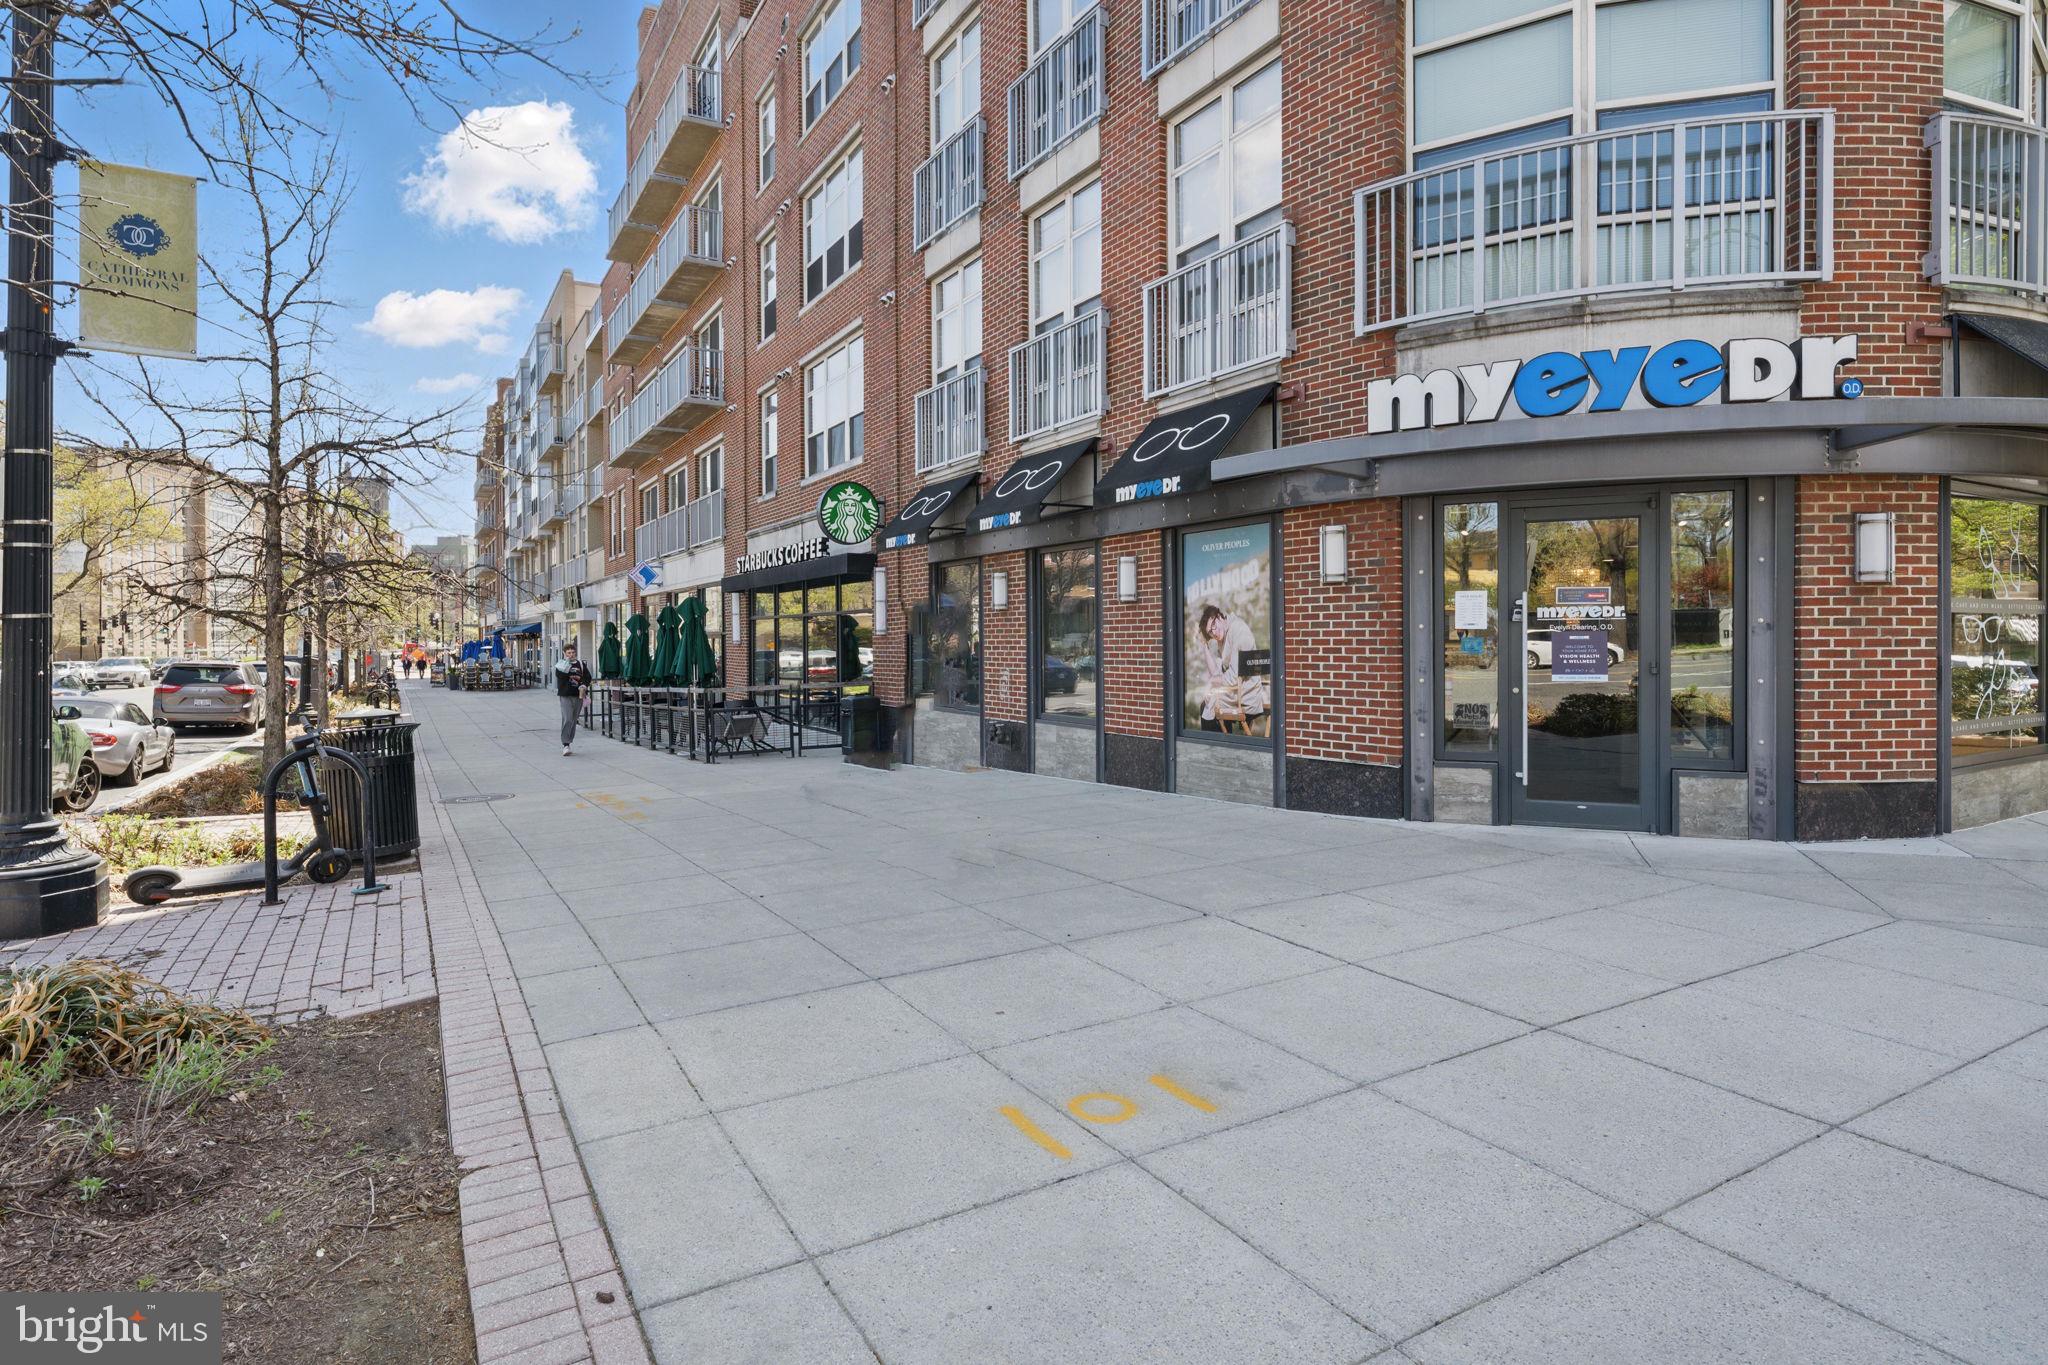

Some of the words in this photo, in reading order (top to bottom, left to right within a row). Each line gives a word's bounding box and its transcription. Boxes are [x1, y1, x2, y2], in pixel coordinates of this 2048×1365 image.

[87, 260, 191, 284] CATHEDRAL
[97, 272, 182, 294] COMMONS
[1201, 542, 1223, 552] OLIVER
[1224, 539, 1250, 549] PEOPLES
[736, 549, 784, 574] STARBUCKS
[785, 537, 824, 563] COFFEE
[1549, 624, 1570, 632] Evelyn
[1464, 703, 1480, 714] NO
